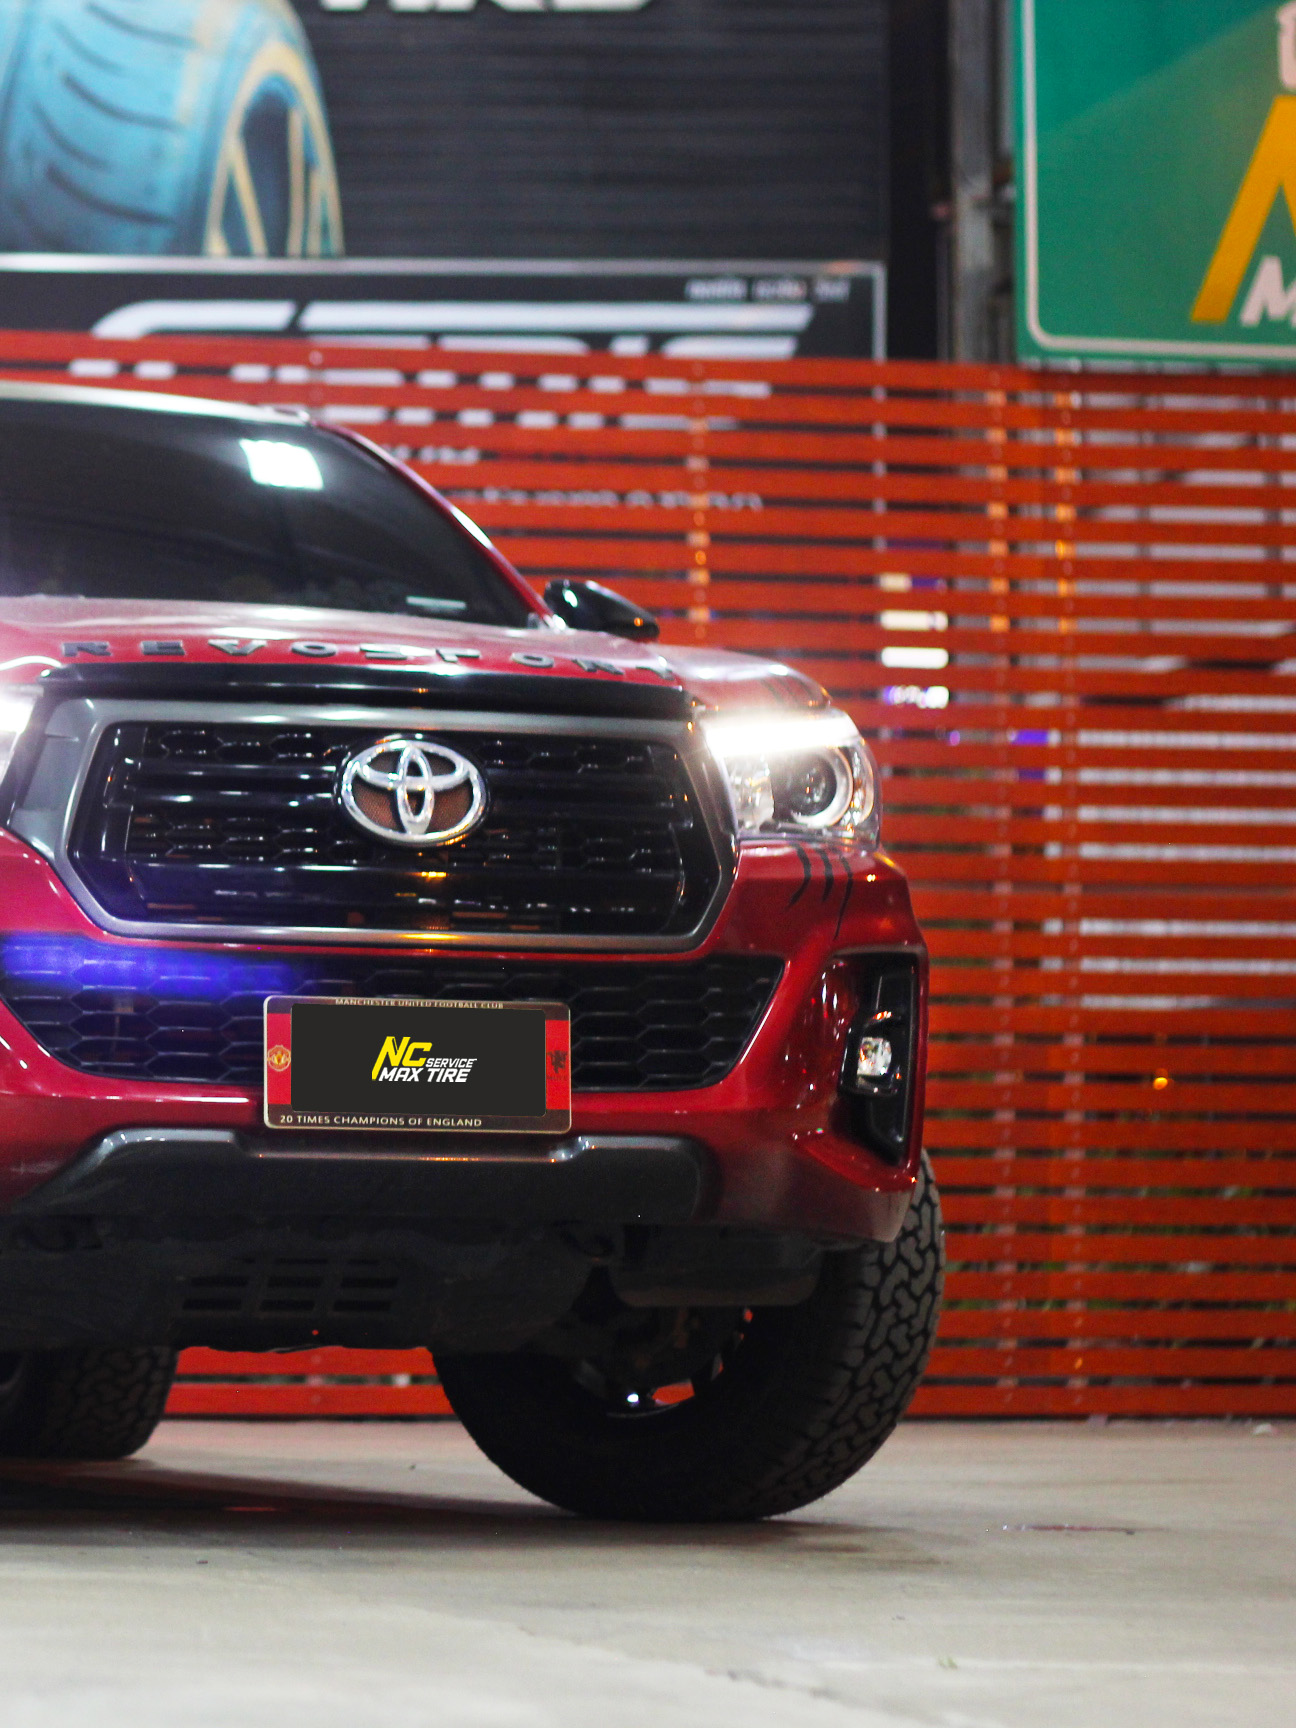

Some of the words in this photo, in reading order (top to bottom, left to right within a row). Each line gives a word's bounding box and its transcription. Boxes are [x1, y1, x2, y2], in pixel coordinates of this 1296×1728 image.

[335, 998, 396, 1007] MANCHESTER
[398, 1000, 432, 1008] UNITED
[434, 1001, 478, 1009] FOOTBALL
[280, 1114, 293, 1123] 20
[296, 1115, 330, 1124] TIMES
[333, 1115, 405, 1126] CHAMPIONS
[408, 1117, 423, 1126] OF
[426, 1117, 482, 1127] ENGLAND
